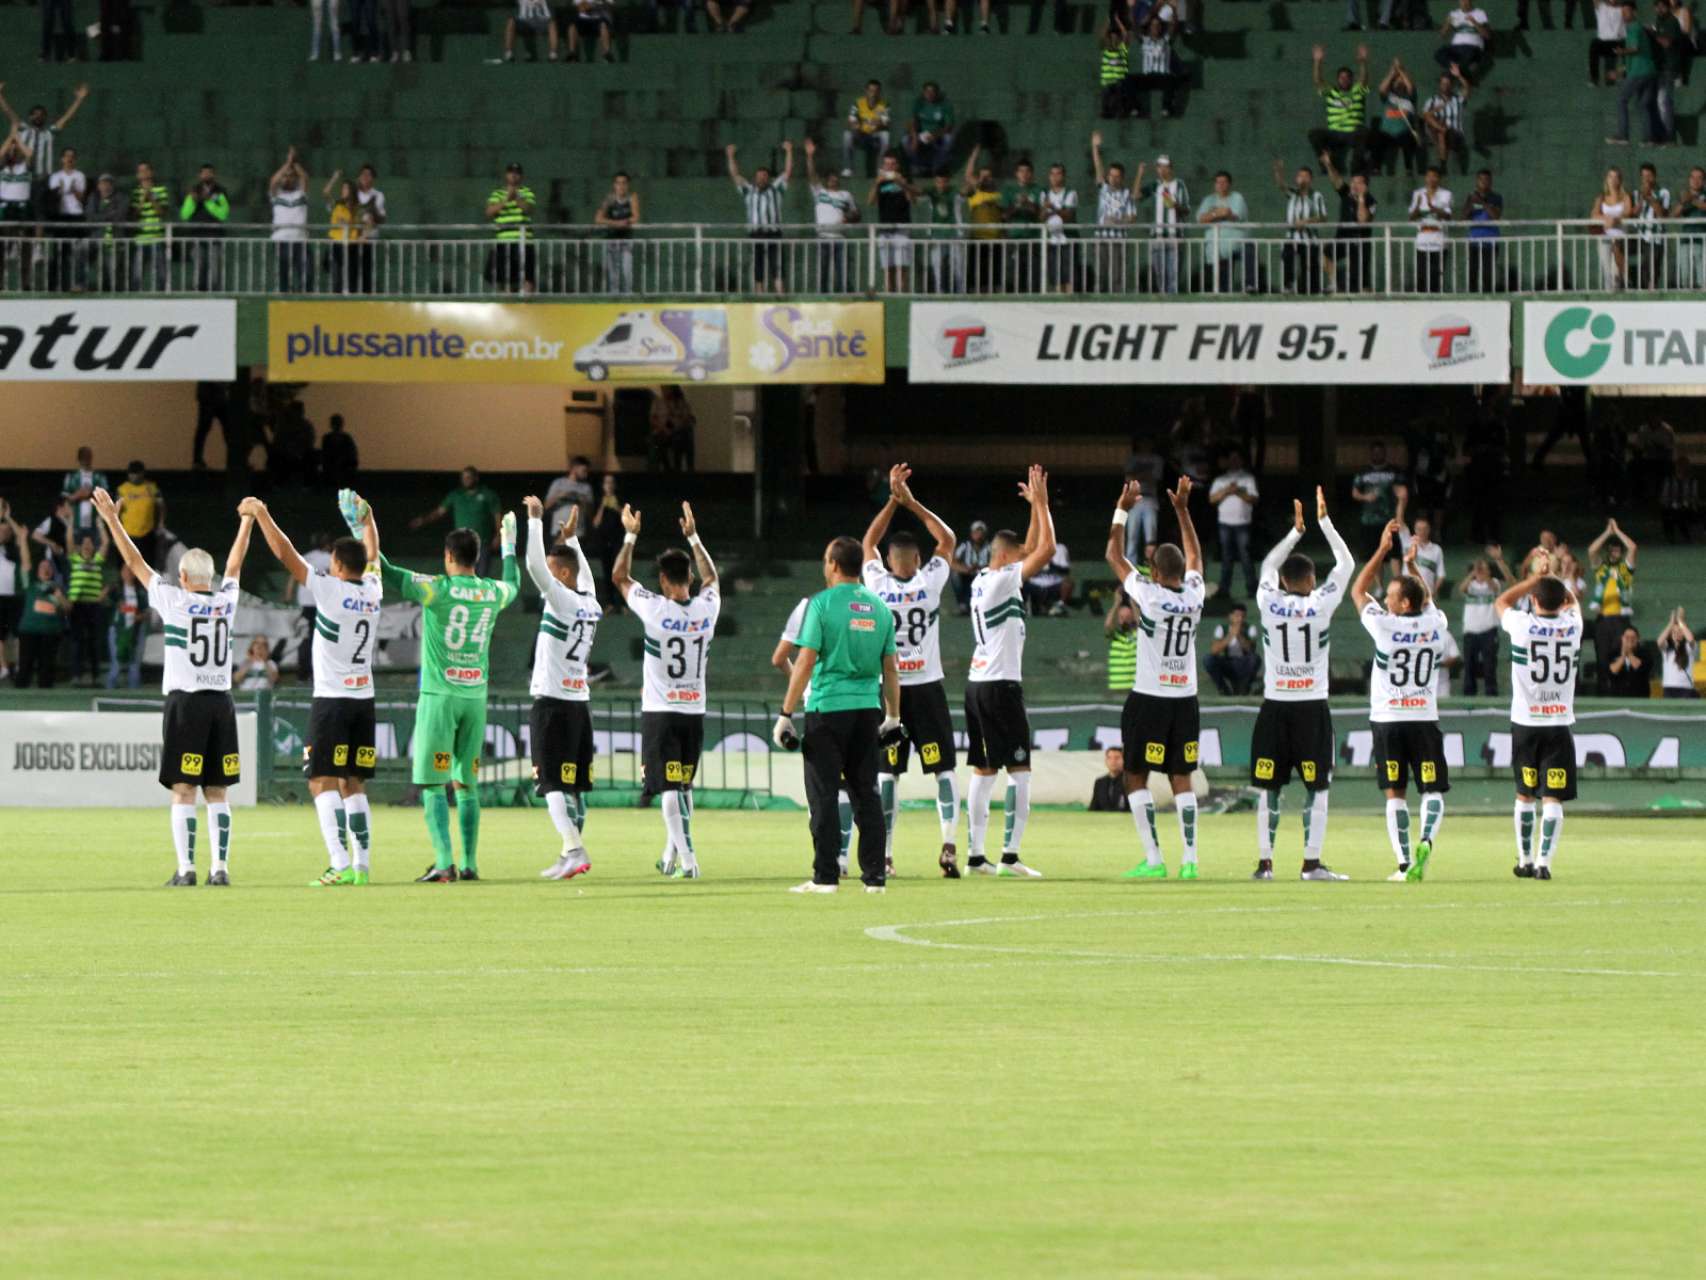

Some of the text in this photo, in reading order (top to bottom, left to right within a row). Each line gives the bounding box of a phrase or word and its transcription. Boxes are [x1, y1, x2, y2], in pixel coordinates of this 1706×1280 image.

[287, 325, 564, 364] plussante.com.br
[1036, 324, 1379, 361] LIGHT FM 95.1
[450, 586, 497, 602] CAIXA
[878, 590, 927, 603] CAIXA
[188, 604, 232, 616] CAIXA
[1270, 603, 1316, 618] CAIXA
[444, 604, 492, 651] 84
[662, 618, 711, 632] CAIXA
[1529, 624, 1576, 638] CAIXA
[190, 618, 228, 667] 50
[352, 619, 370, 664] 2
[1163, 615, 1192, 657] 16
[1275, 622, 1312, 663] 11
[1392, 630, 1439, 643] CAIXA
[667, 635, 704, 679] 31
[1530, 640, 1573, 684] 55
[898, 660, 925, 671] RDP
[1390, 648, 1434, 687] 30
[13, 743, 74, 770] JOGOS
[358, 748, 374, 759] 99
[1148, 744, 1163, 756] 99
[184, 754, 201, 768] 99
[1258, 762, 1273, 773] 99
[1548, 769, 1564, 780] 99
